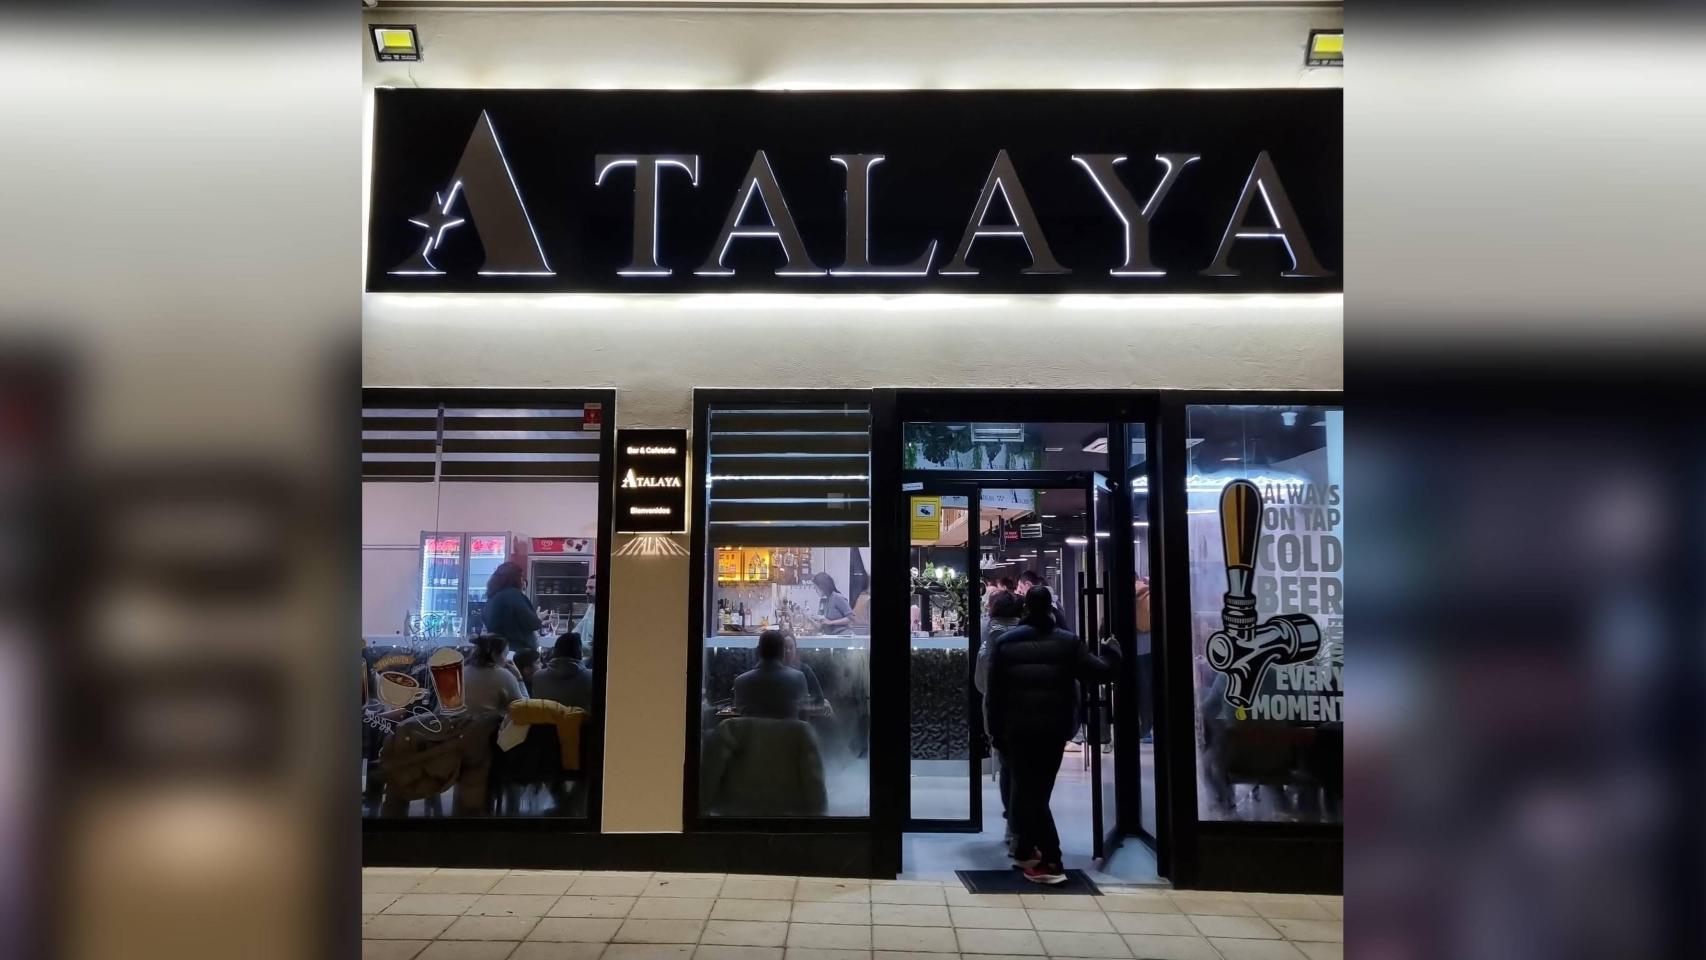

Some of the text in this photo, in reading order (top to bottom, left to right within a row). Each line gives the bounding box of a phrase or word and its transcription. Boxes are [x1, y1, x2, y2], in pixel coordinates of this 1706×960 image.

[386, 110, 1338, 277] ATALAYA
[626, 446, 639, 455] Bar
[639, 446, 646, 455] &
[621, 468, 681, 488] ATALAYA
[1262, 483, 1340, 505] ALWAYS
[1263, 507, 1341, 532] ON TAP
[1258, 534, 1343, 573] COLD
[1257, 576, 1343, 615] BEER
[1275, 665, 1343, 692] EVERY
[1252, 694, 1343, 722] MOMENT
